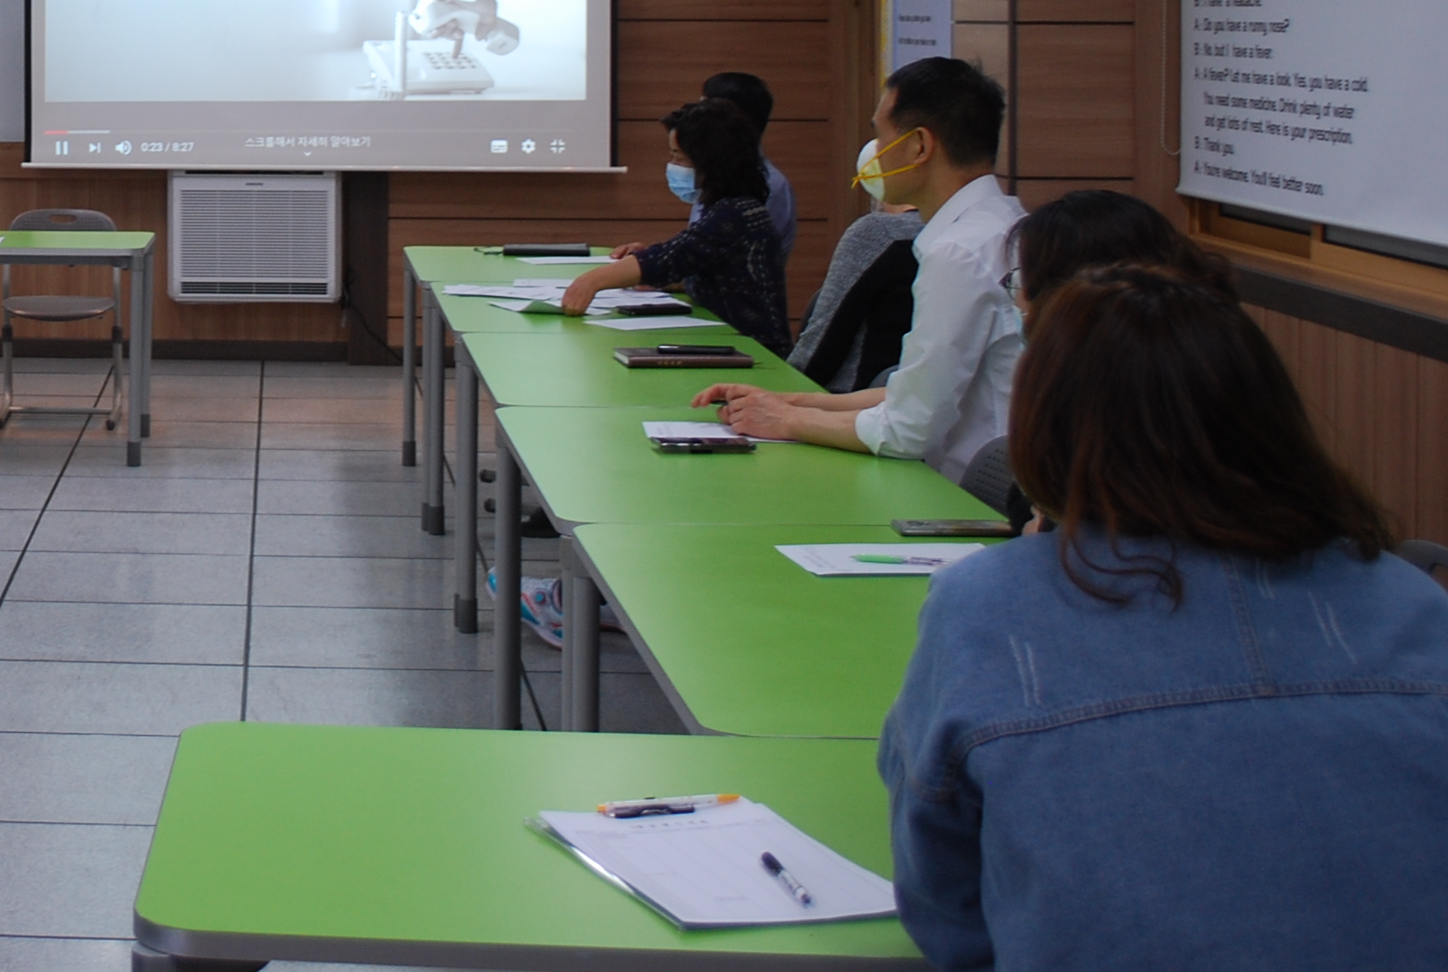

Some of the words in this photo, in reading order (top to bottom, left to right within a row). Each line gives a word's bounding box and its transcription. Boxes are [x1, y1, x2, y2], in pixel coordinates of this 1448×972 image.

[140, 142, 164, 153] 0:23
[172, 142, 196, 153] 8:27
[244, 135, 296, 148] 스크롤해서
[297, 135, 328, 148] 자세히
